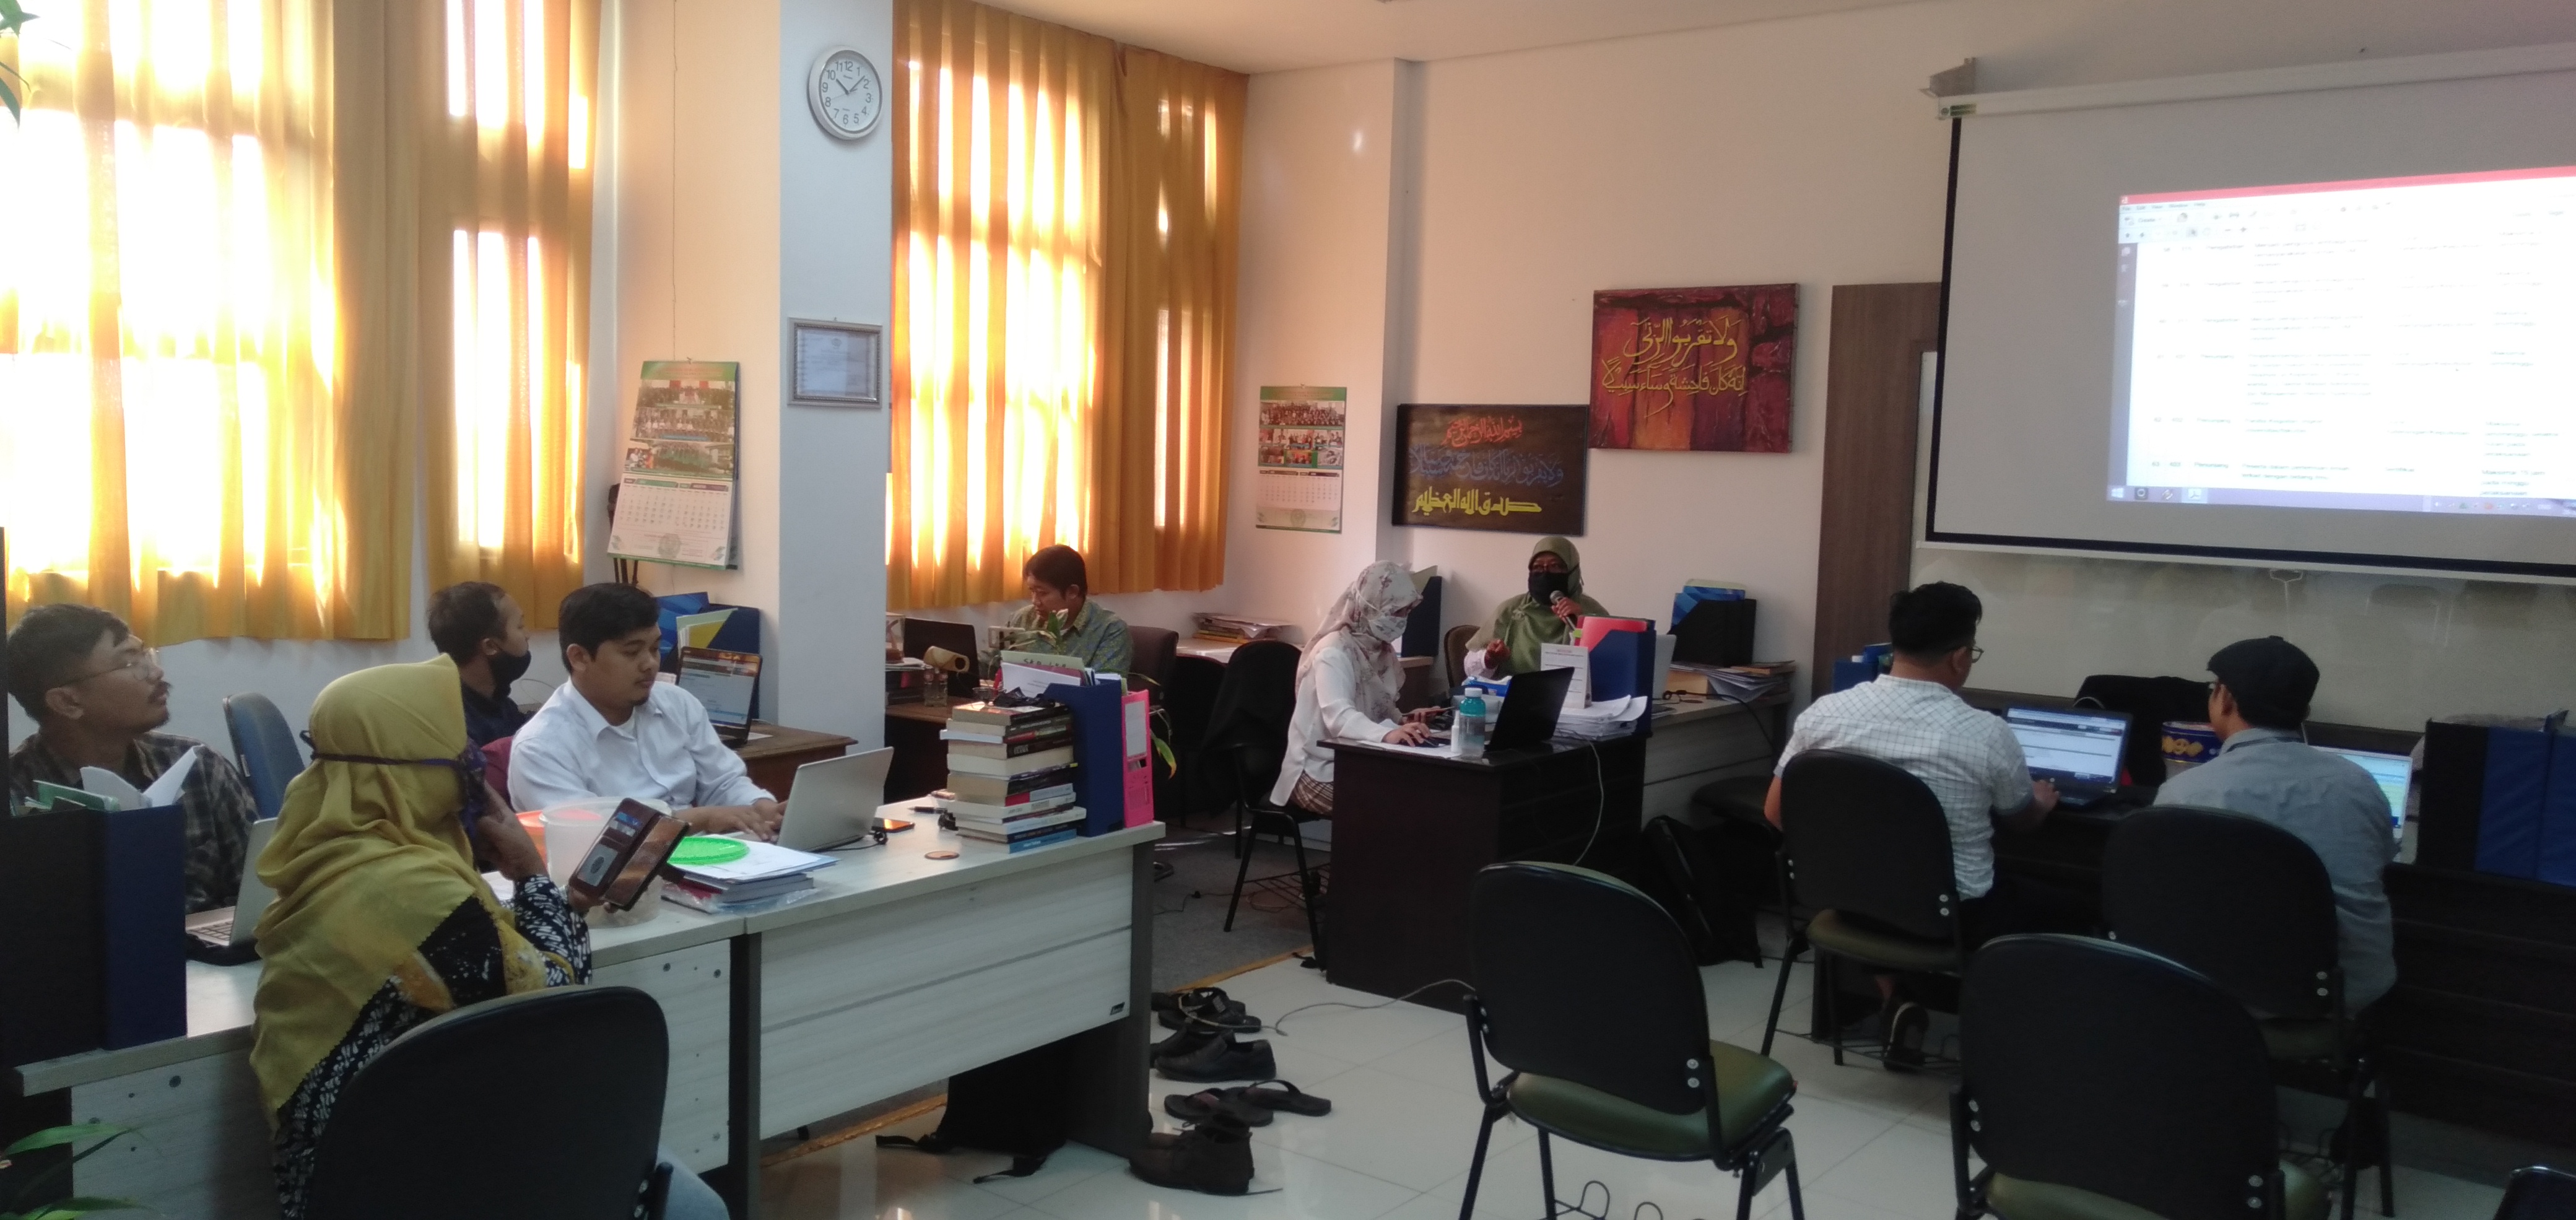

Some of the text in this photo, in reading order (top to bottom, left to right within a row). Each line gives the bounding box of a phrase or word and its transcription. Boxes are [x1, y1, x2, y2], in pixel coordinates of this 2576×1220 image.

[835, 61, 843, 72] 11
[844, 61, 853, 72] 12
[856, 66, 860, 76] 1
[826, 69, 836, 81] 10
[822, 82, 829, 92] 9
[863, 79, 869, 89] 2
[824, 97, 831, 107] 8
[865, 93, 872, 103] 3
[833, 108, 840, 118] 7
[861, 106, 867, 115] 4
[843, 114, 849, 124] 6
[853, 113, 859, 124] 5
